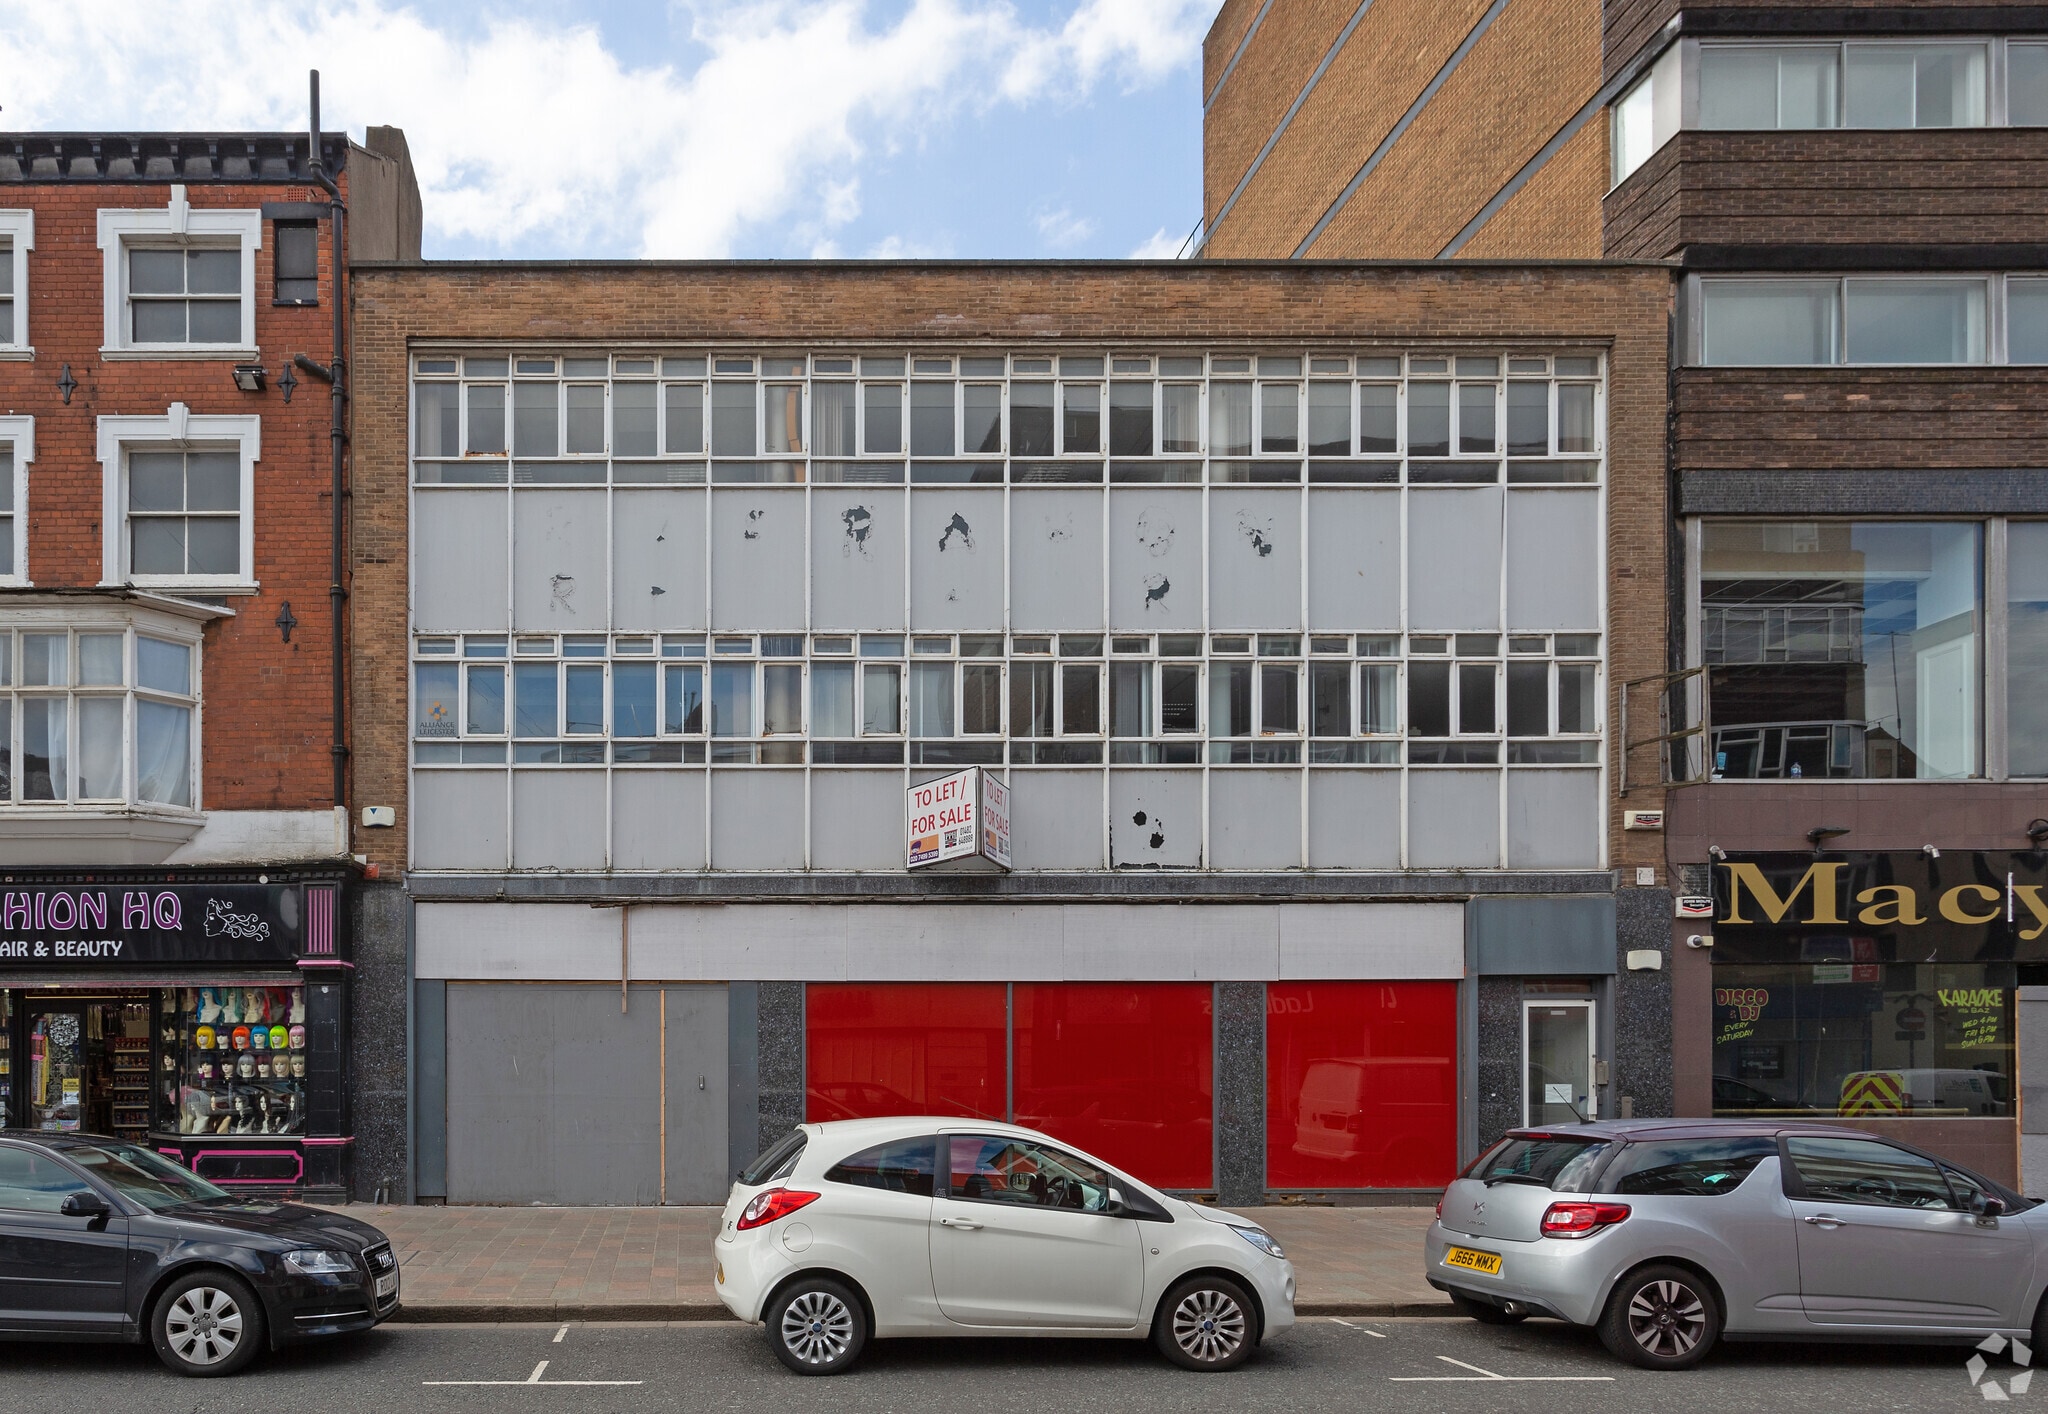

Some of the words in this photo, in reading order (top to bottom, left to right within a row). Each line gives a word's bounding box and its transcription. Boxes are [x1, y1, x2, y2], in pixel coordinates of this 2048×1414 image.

[914, 789, 932, 809] TO
[936, 780, 957, 803] LET
[985, 779, 994, 799] TO
[994, 786, 1003, 806] LET
[911, 814, 936, 835] FOR
[939, 803, 972, 829] SALE
[984, 806, 996, 829] FOR
[996, 813, 1009, 836] SALE
[1717, 862, 2048, 940] Macy
[0, 891, 107, 930] HION
[122, 891, 182, 931] HQ
[33, 940, 49, 957] &
[55, 940, 123, 957] BEAUTY
[1715, 988, 1769, 1006] DISCO
[1937, 989, 2003, 1007] KARAOKE
[1738, 1005, 1760, 1021] DJ
[1724, 1021, 1749, 1032] EVERY
[1962, 1019, 1978, 1029] WED
[1716, 1029, 1754, 1045] SATURDAY
[1964, 1029, 1978, 1038] FRI
[1961, 1039, 1977, 1049] SUN
[1450, 1250, 1475, 1266] J666
[1474, 1254, 1498, 1271] MMX
